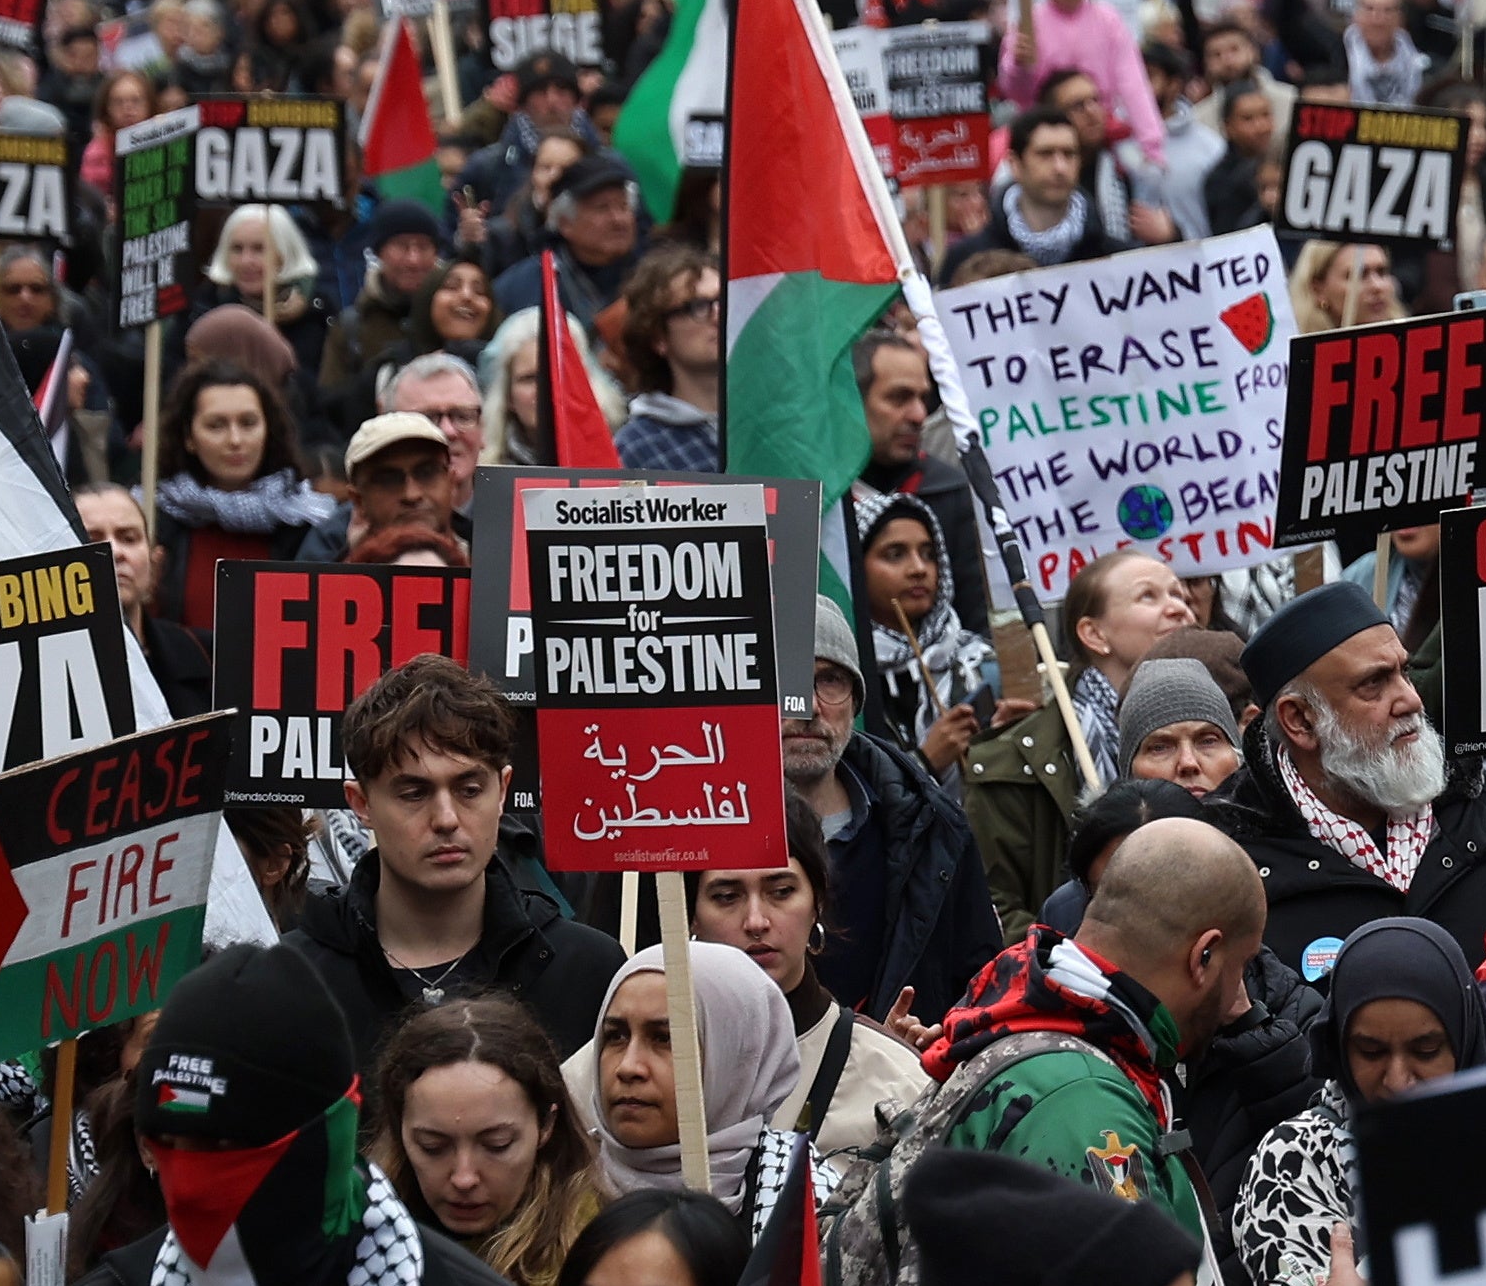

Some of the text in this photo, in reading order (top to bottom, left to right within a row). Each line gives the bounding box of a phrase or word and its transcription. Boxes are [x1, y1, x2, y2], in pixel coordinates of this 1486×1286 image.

[489, 13, 604, 70] SIEGE
[883, 43, 978, 78] FREEDOM
[195, 127, 340, 200] GAZA
[1284, 139, 1453, 240] GAZA
[952, 252, 1271, 340] THEY WANTED
[968, 325, 1218, 390] TO ERASE
[979, 381, 1229, 448] PALESTINE
[1306, 318, 1486, 462] FREE
[995, 452, 1074, 504] THE
[1299, 442, 1477, 520] PALESTINE
[1013, 500, 1101, 552] THE
[548, 540, 744, 604] FREEDOM
[626, 603, 662, 634] for
[546, 632, 762, 695] PALESTINE
[784, 696, 806, 713] FOA
[582, 719, 726, 782] الحرية
[45, 728, 212, 846] CEASE
[572, 780, 752, 840] لفلسطين
[60, 832, 180, 940] FIRE
[41, 921, 168, 1039] NOW
[152, 1066, 228, 1096] PALESTINE
[168, 1053, 213, 1073] FREE
